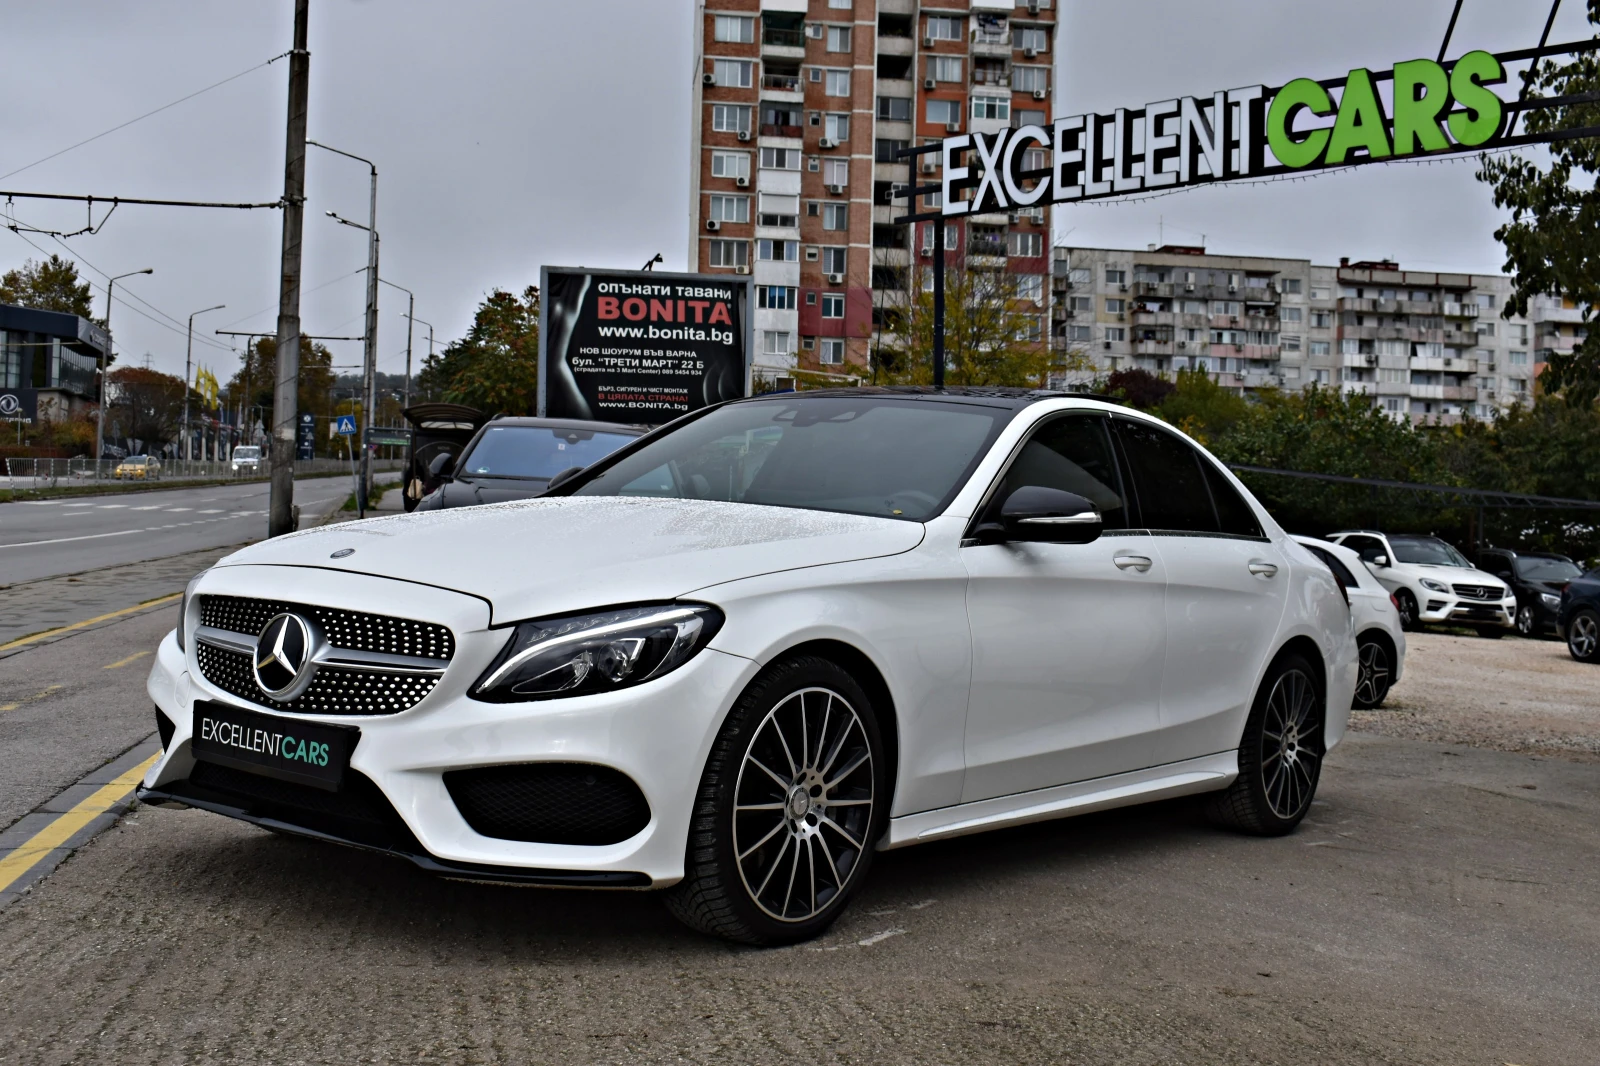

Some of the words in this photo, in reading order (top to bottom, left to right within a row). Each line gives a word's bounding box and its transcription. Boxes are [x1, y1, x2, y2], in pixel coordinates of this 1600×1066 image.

[598, 283, 671, 296] опънати
[676, 286, 731, 300] тавани
[597, 296, 732, 326] BONITA
[598, 325, 733, 345] www.bonita.bg
[580, 347, 600, 355] НОВ
[602, 348, 641, 356] ШОУРУМ
[644, 349, 664, 357] ВЪВ
[666, 350, 697, 358] ВАРНА
[572, 357, 595, 367] бул.
[681, 360, 694, 369] 22
[696, 361, 704, 369] Б
[607, 393, 646, 401] ЦЯЛАТА
[648, 394, 688, 402] СТРАНА!
[598, 402, 688, 411] www.BONITA.bg
